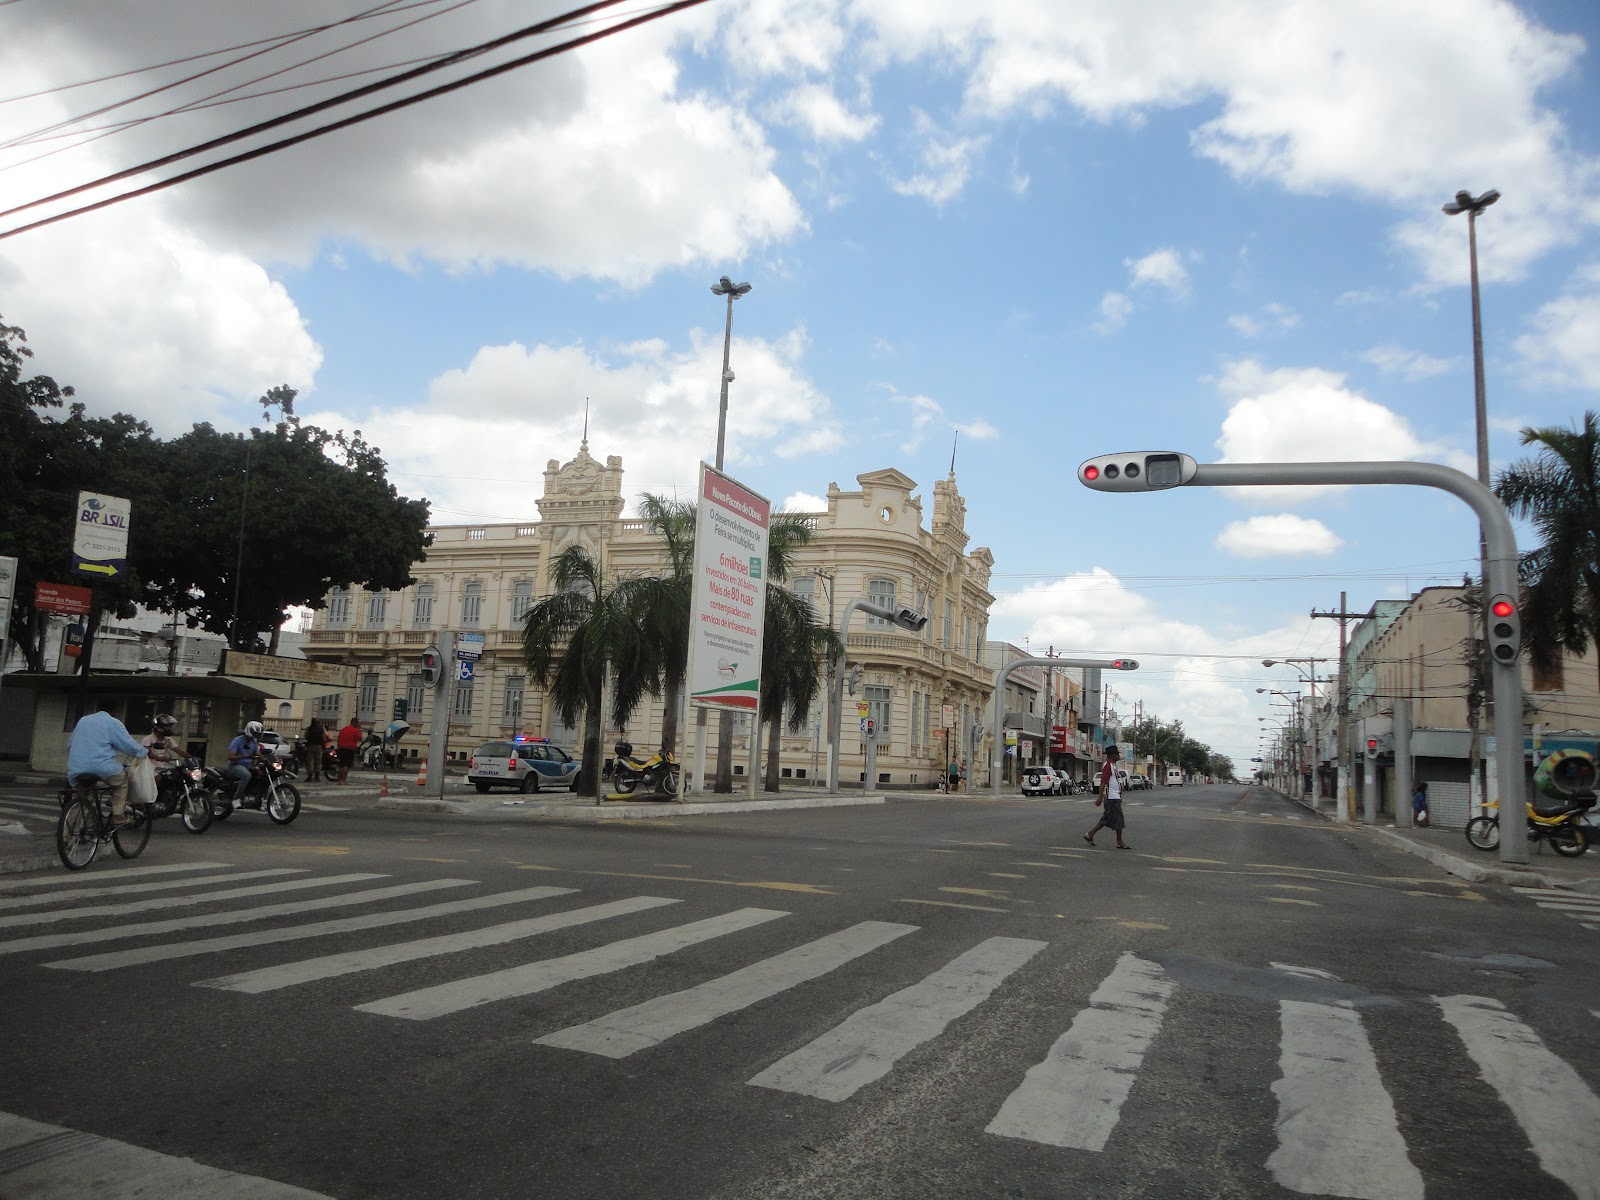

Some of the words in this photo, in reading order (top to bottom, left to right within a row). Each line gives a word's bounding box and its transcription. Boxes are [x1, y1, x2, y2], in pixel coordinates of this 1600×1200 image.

[712, 486, 725, 502] Novo
[726, 493, 742, 511] Pacote
[742, 503, 748, 514] de
[748, 506, 762, 521] Obras
[710, 508, 714, 519] O
[715, 512, 754, 538] desenvolvimento
[755, 530, 760, 542] de
[714, 524, 726, 538] Feira
[727, 533, 732, 542] se
[706, 564, 730, 582] investidos
[730, 576, 737, 584] em
[738, 578, 744, 587] 20
[720, 552, 724, 566] 6
[725, 556, 748, 576] milhões
[709, 581, 722, 596] Mais
[724, 586, 730, 598] de
[731, 587, 740, 601] 80
[740, 593, 754, 606] ruas
[710, 600, 742, 618] contempladas
[742, 610, 752, 620] com
[701, 614, 720, 626] serviços
[721, 618, 727, 627] de
[728, 619, 757, 636] infraestrutura.
[278, 660, 306, 668] MILITAR
